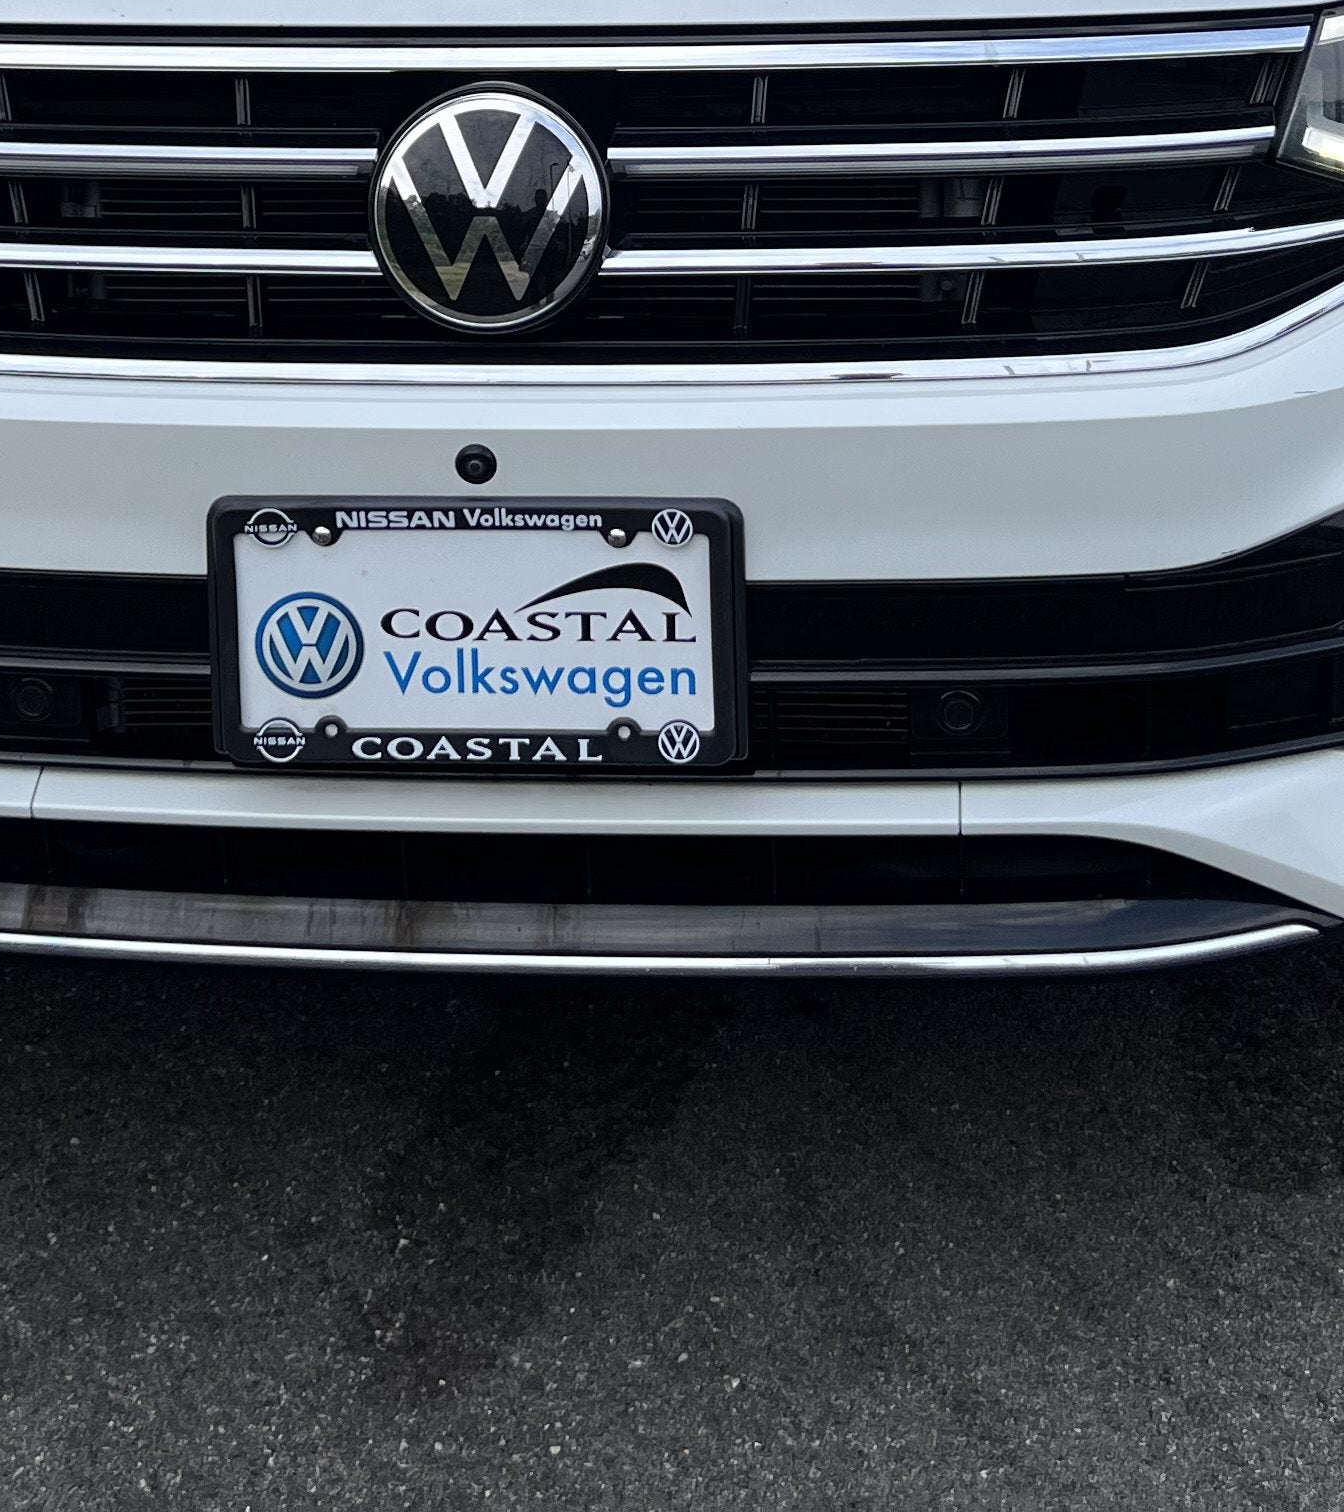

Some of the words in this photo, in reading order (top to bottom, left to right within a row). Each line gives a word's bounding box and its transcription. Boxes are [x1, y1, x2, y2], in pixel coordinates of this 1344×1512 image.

[244, 523, 298, 534] NISSAN
[335, 510, 456, 529] NISSAN
[462, 507, 603, 531] Volkswagen
[380, 607, 697, 643] COASTAL
[383, 647, 697, 707] Volkswagen
[253, 735, 306, 746] NISSAN
[351, 735, 603, 763] COASTAL
